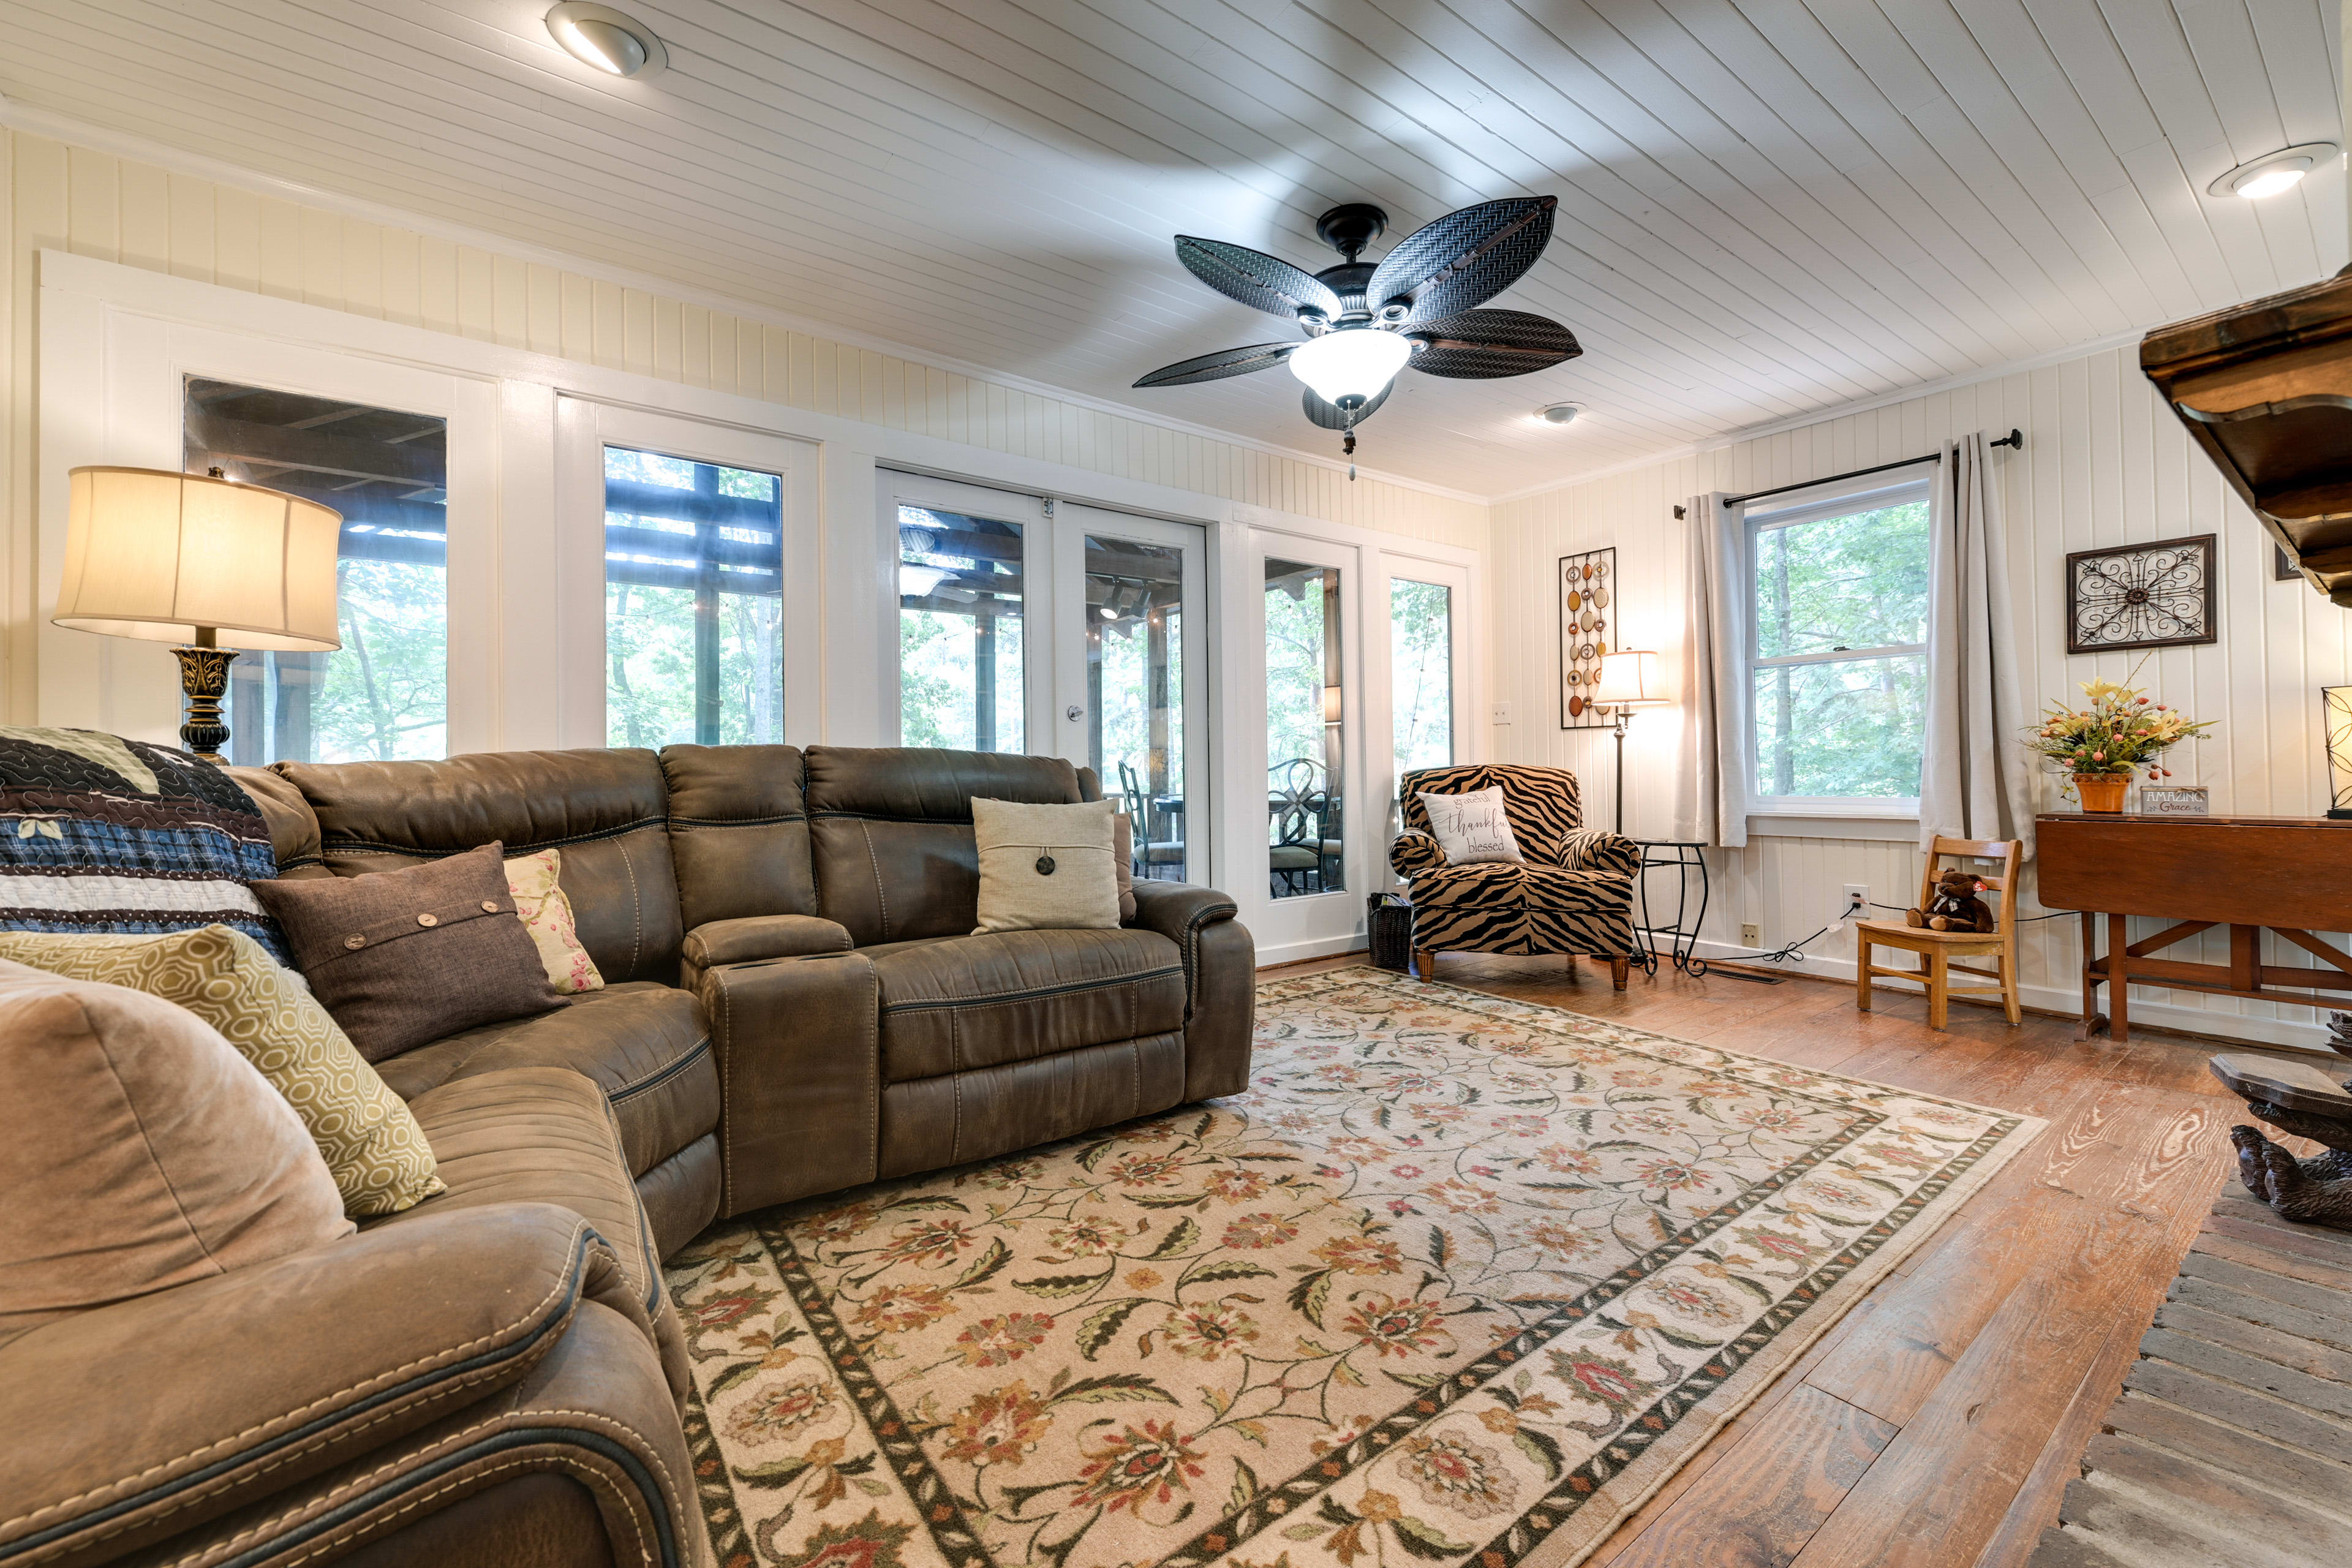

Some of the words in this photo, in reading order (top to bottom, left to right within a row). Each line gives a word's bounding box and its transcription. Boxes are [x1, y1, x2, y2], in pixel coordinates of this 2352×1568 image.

[1453, 793, 1491, 809] grateful
[2146, 791, 2203, 802] AMAZING
[2160, 801, 2191, 812] Grace
[1467, 835, 1504, 853] blessed
